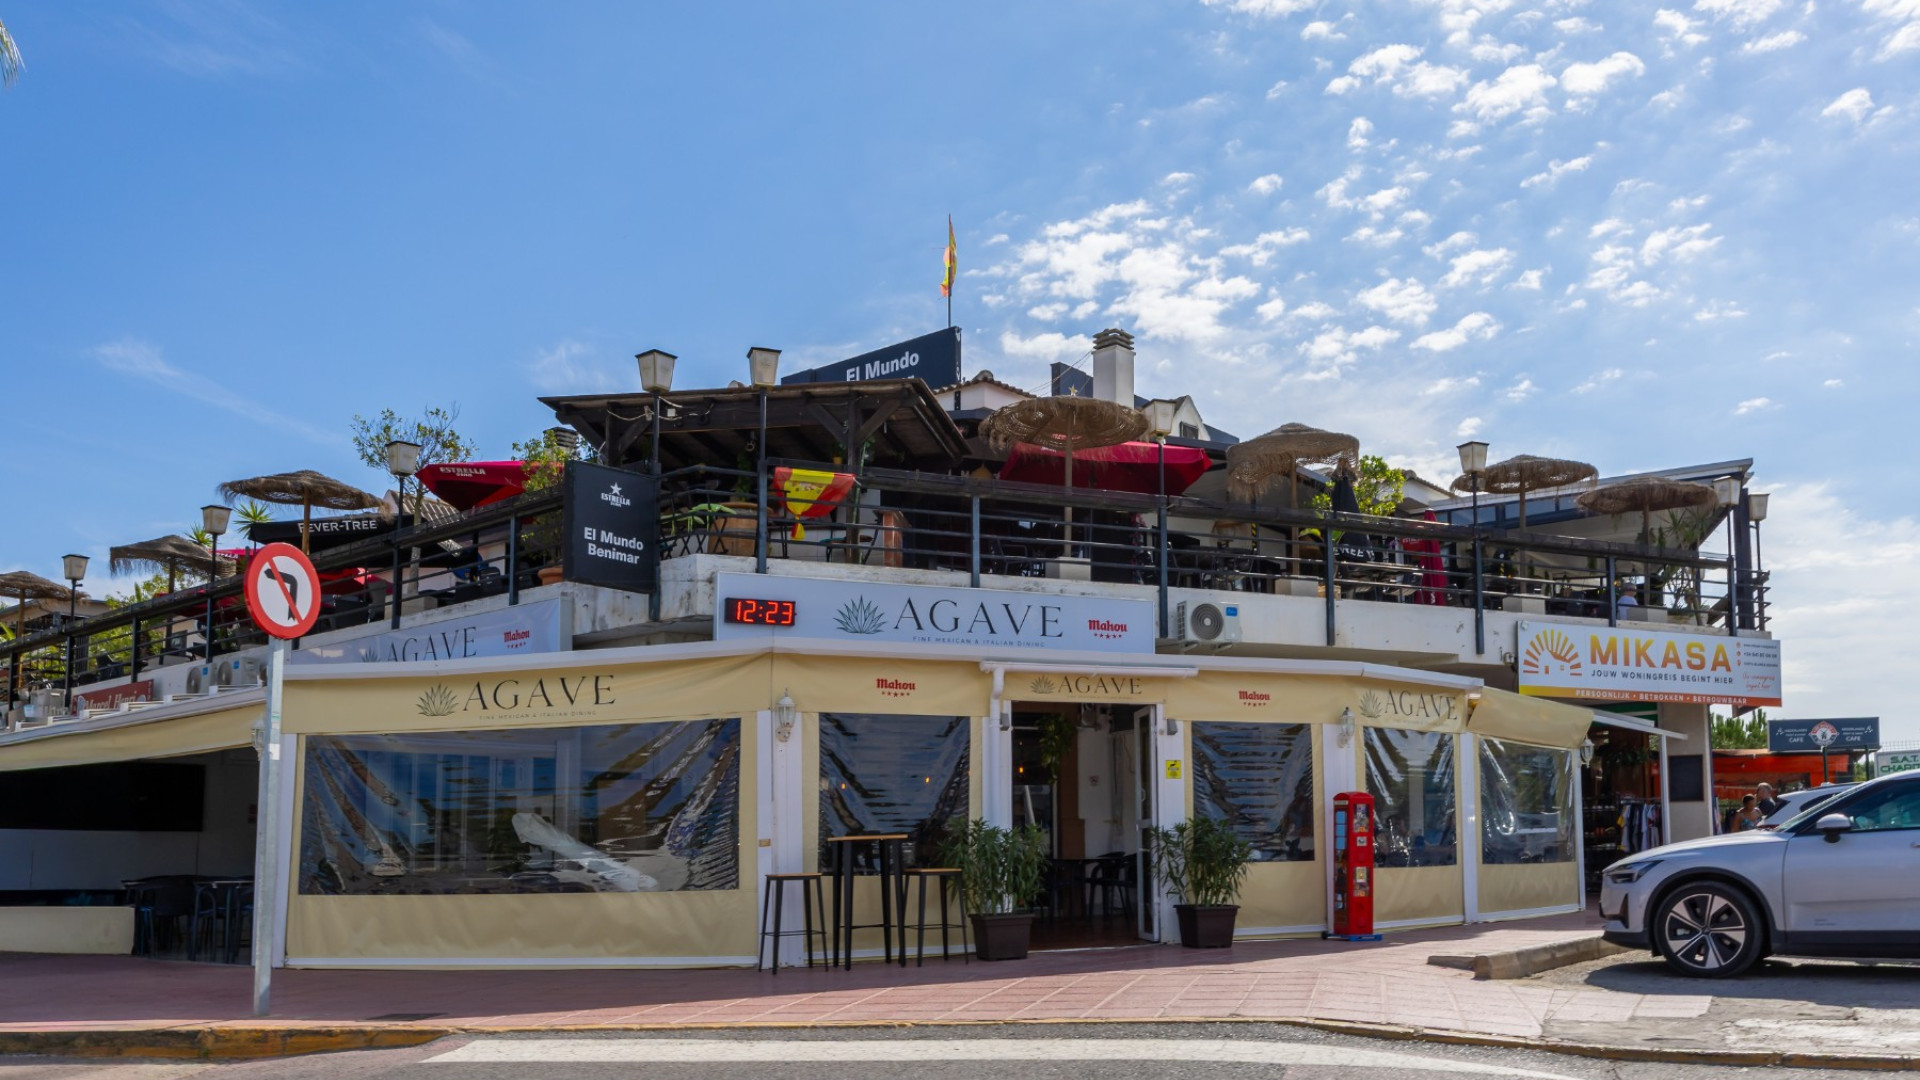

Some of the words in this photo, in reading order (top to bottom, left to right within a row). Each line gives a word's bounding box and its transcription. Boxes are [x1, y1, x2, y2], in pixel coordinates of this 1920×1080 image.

[846, 366, 860, 381] El
[865, 351, 920, 379] Mundo
[440, 466, 486, 475] ESTRELLA
[601, 493, 631, 506] ESTRELLA
[584, 527, 596, 541] El
[600, 530, 644, 551] Mundo
[588, 543, 640, 564] Benimar
[736, 600, 793, 624] 12:23
[894, 597, 1063, 638] AGAVE
[1088, 619, 1127, 632] Mahou
[387, 626, 477, 662] AGAVE
[504, 629, 530, 642] Mahou
[936, 637, 971, 645] MEXICAN
[982, 639, 1013, 647] ITALIAN
[1590, 634, 1732, 673] MIKASA
[877, 678, 916, 690] Mahou
[1058, 676, 1142, 695] AGAVE
[1591, 669, 1617, 678] JOUW
[1621, 671, 1677, 682] WONINGREIS
[1680, 674, 1711, 683] BEGINT
[1714, 676, 1733, 685] HIER
[463, 675, 616, 711] AGAVE
[1239, 690, 1271, 700] Mahou
[1575, 689, 1630, 699] PERSOONLIJK
[1639, 693, 1684, 701] BETROKKEN
[1693, 695, 1747, 705] BETROUWBAAR
[1384, 688, 1458, 720] AGAVE
